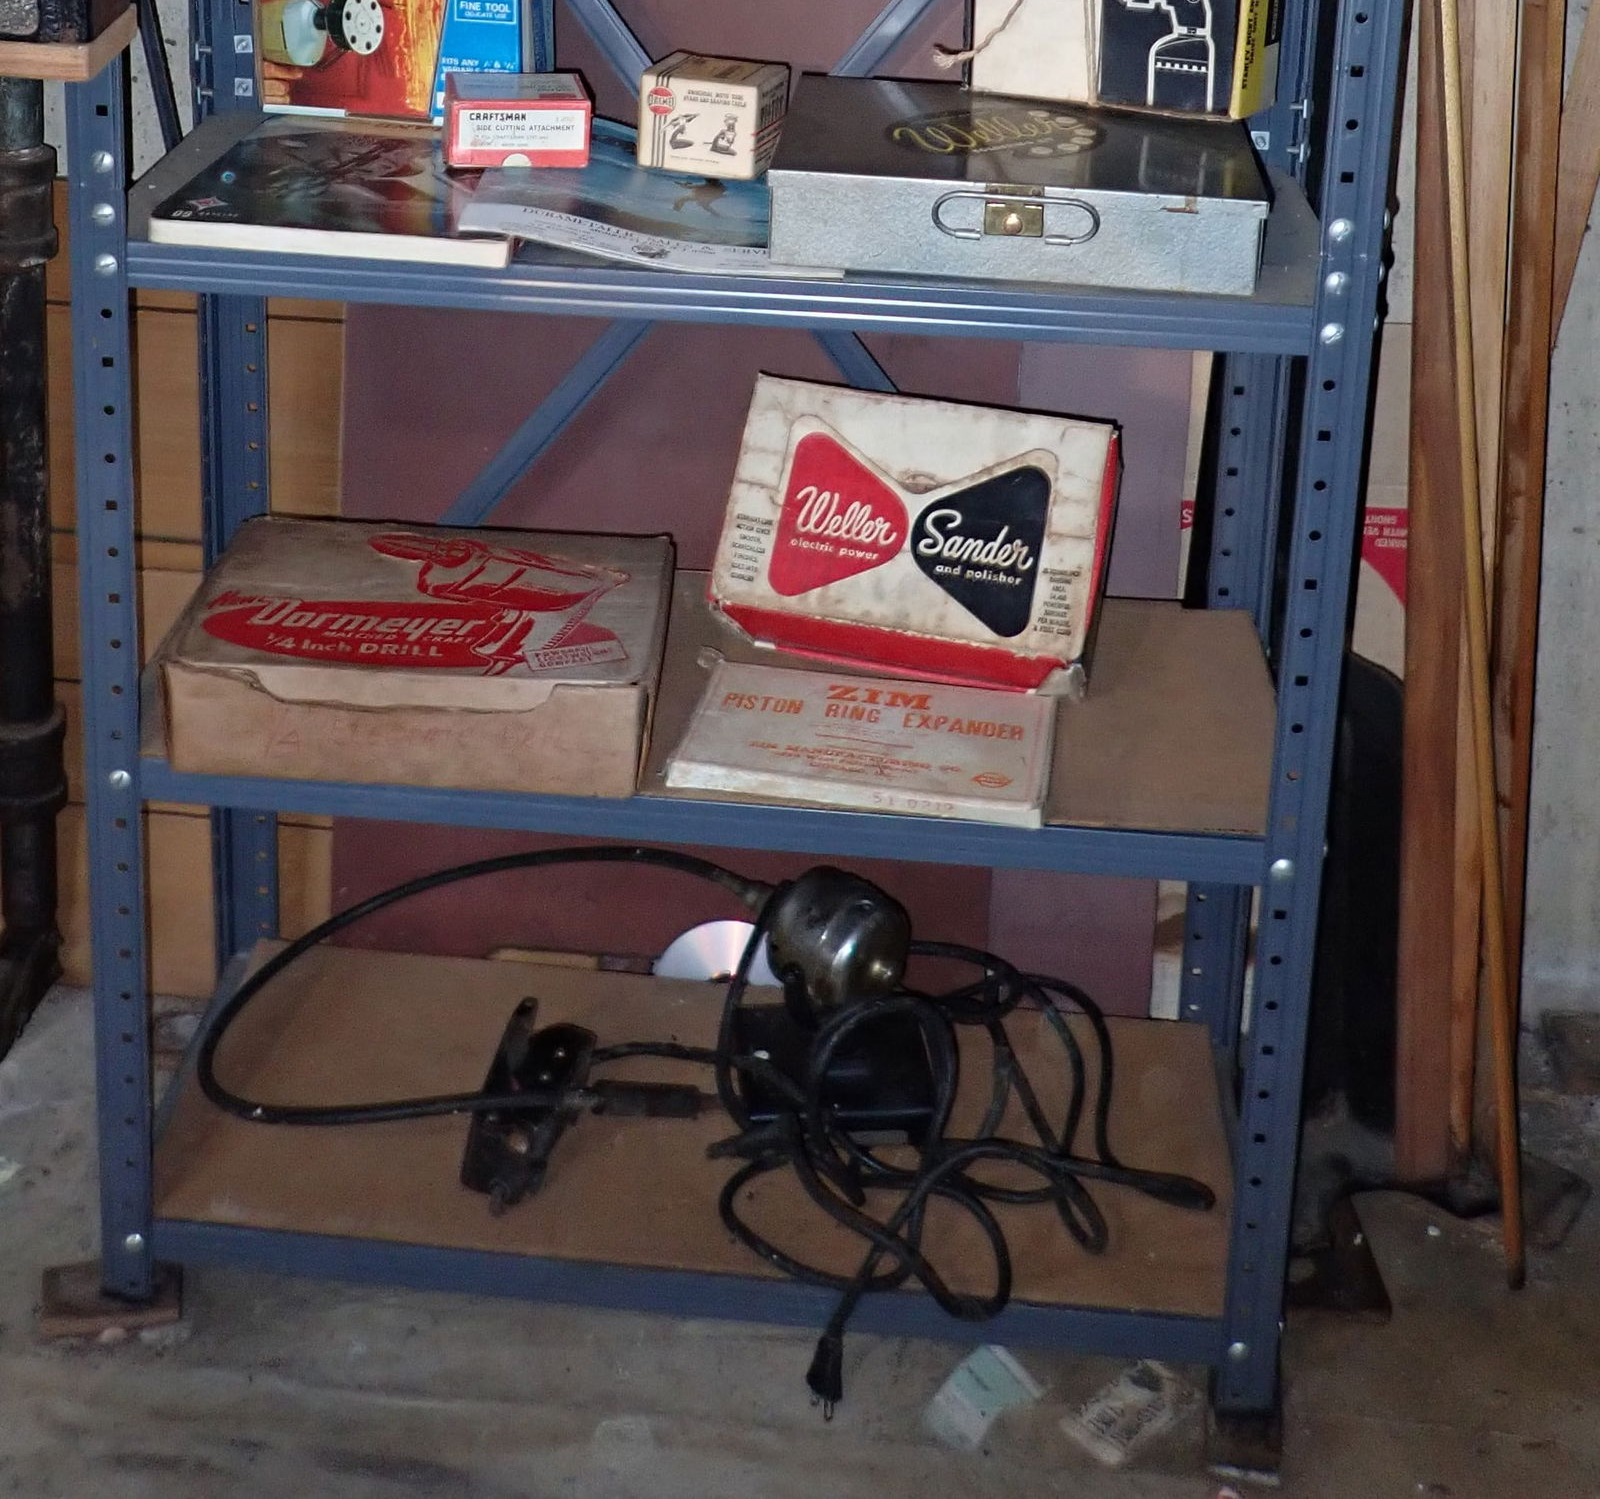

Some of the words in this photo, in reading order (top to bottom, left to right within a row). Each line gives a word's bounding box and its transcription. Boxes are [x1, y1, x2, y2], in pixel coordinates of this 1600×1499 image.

[459, 1, 481, 11] FINE
[485, 2, 511, 13] TOOL
[469, 112, 527, 121] CRAFTSMAN
[796, 486, 898, 546] Weller
[790, 536, 835, 552] electric
[839, 547, 881, 562] power
[917, 508, 1035, 570] Sander
[935, 562, 963, 576] and
[966, 567, 1023, 587] polisher
[247, 598, 486, 642] Dormeyer
[301, 639, 352, 653] Inch
[358, 642, 444, 658] DRILL
[422, 635, 476, 644] CRAFT
[826, 684, 934, 710] ZIM
[720, 692, 804, 715] PISTON
[824, 702, 881, 724] RING
[902, 712, 1025, 742] EXPANDER
